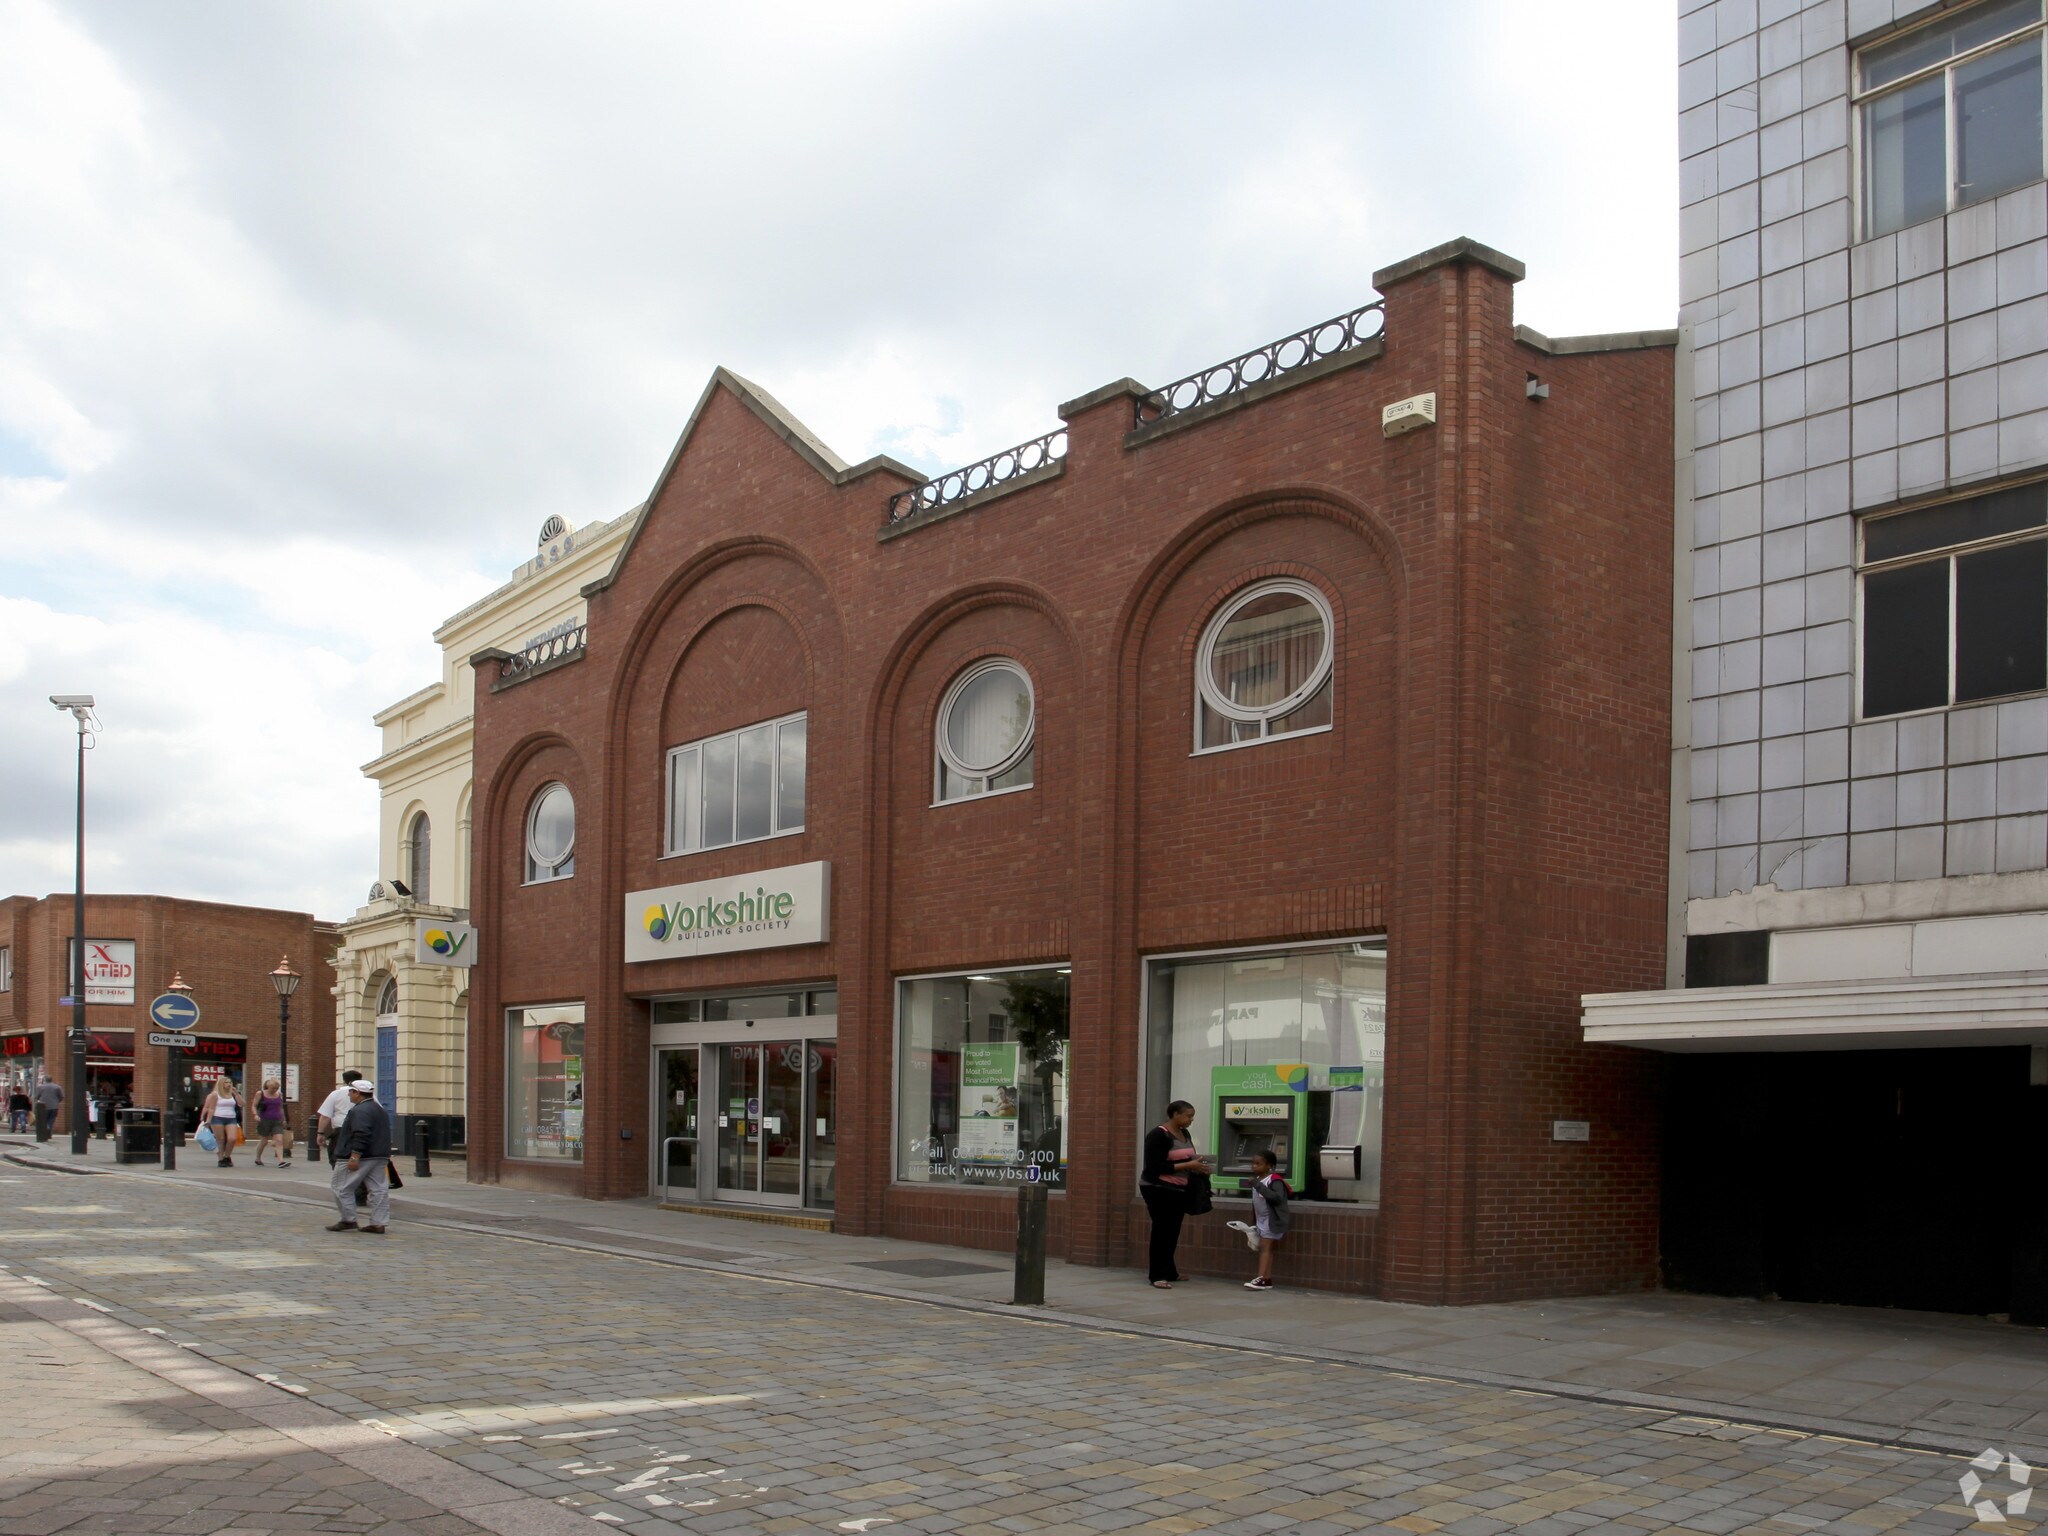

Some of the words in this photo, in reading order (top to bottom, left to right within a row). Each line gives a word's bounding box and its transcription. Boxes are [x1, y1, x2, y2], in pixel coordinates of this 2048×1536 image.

[677, 927, 732, 941] BUILDING
[738, 919, 791, 934] SOCIETY
[173, 1037, 192, 1045] way
[194, 1065, 225, 1073] SALE
[1247, 1072, 1267, 1080] your
[1241, 1078, 1272, 1089] cash
[537, 1125, 554, 1135] 0845
[922, 1146, 943, 1158] call
[952, 1146, 984, 1160] 0845
[1030, 1150, 1054, 1163] 100
[908, 1165, 921, 1174] or
[927, 1163, 956, 1176] click
